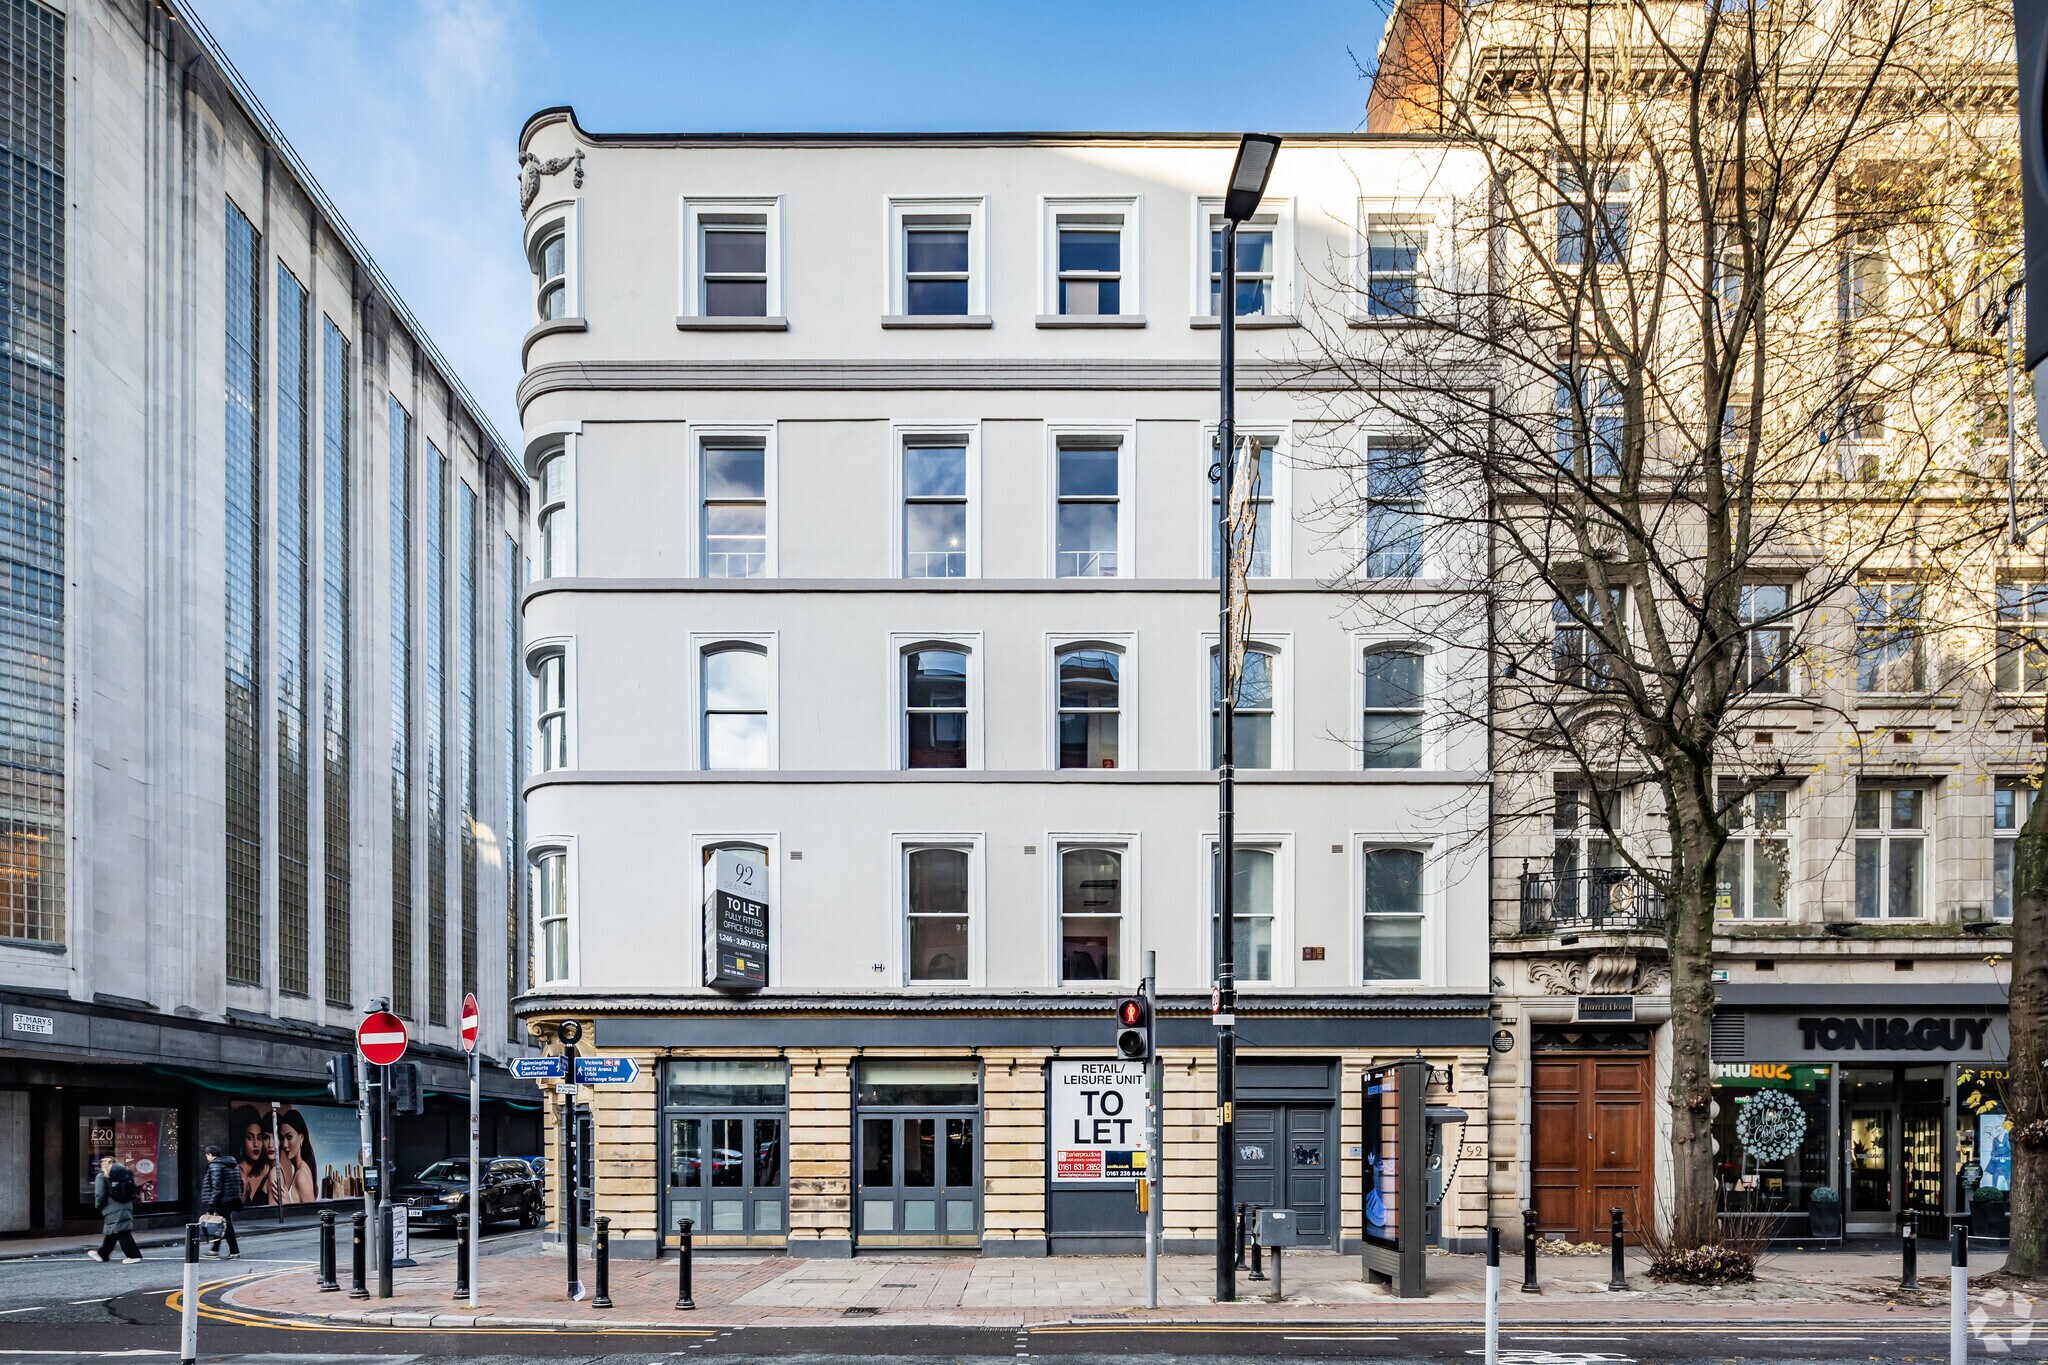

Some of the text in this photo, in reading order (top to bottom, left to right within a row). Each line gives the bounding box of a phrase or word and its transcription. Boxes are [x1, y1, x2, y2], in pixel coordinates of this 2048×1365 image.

[736, 863, 754, 886] 92
[724, 881, 766, 900] DEANSGATE
[726, 896, 762, 916] TO LET
[725, 910, 762, 928] FULLY FITTED
[723, 920, 764, 938] OFFICE SUITES
[752, 942, 760, 950] SQ
[1580, 1002, 1633, 1010] Church House
[18, 1022, 45, 1032] STREET
[1799, 1018, 1993, 1050] TONI&GUY
[1081, 1064, 1126, 1074] RETAIL/
[1064, 1075, 1143, 1084] LEISURE UNIT
[1080, 1090, 1124, 1116] TO
[91, 1129, 114, 1140] £20
[1074, 1118, 1133, 1144] LET
